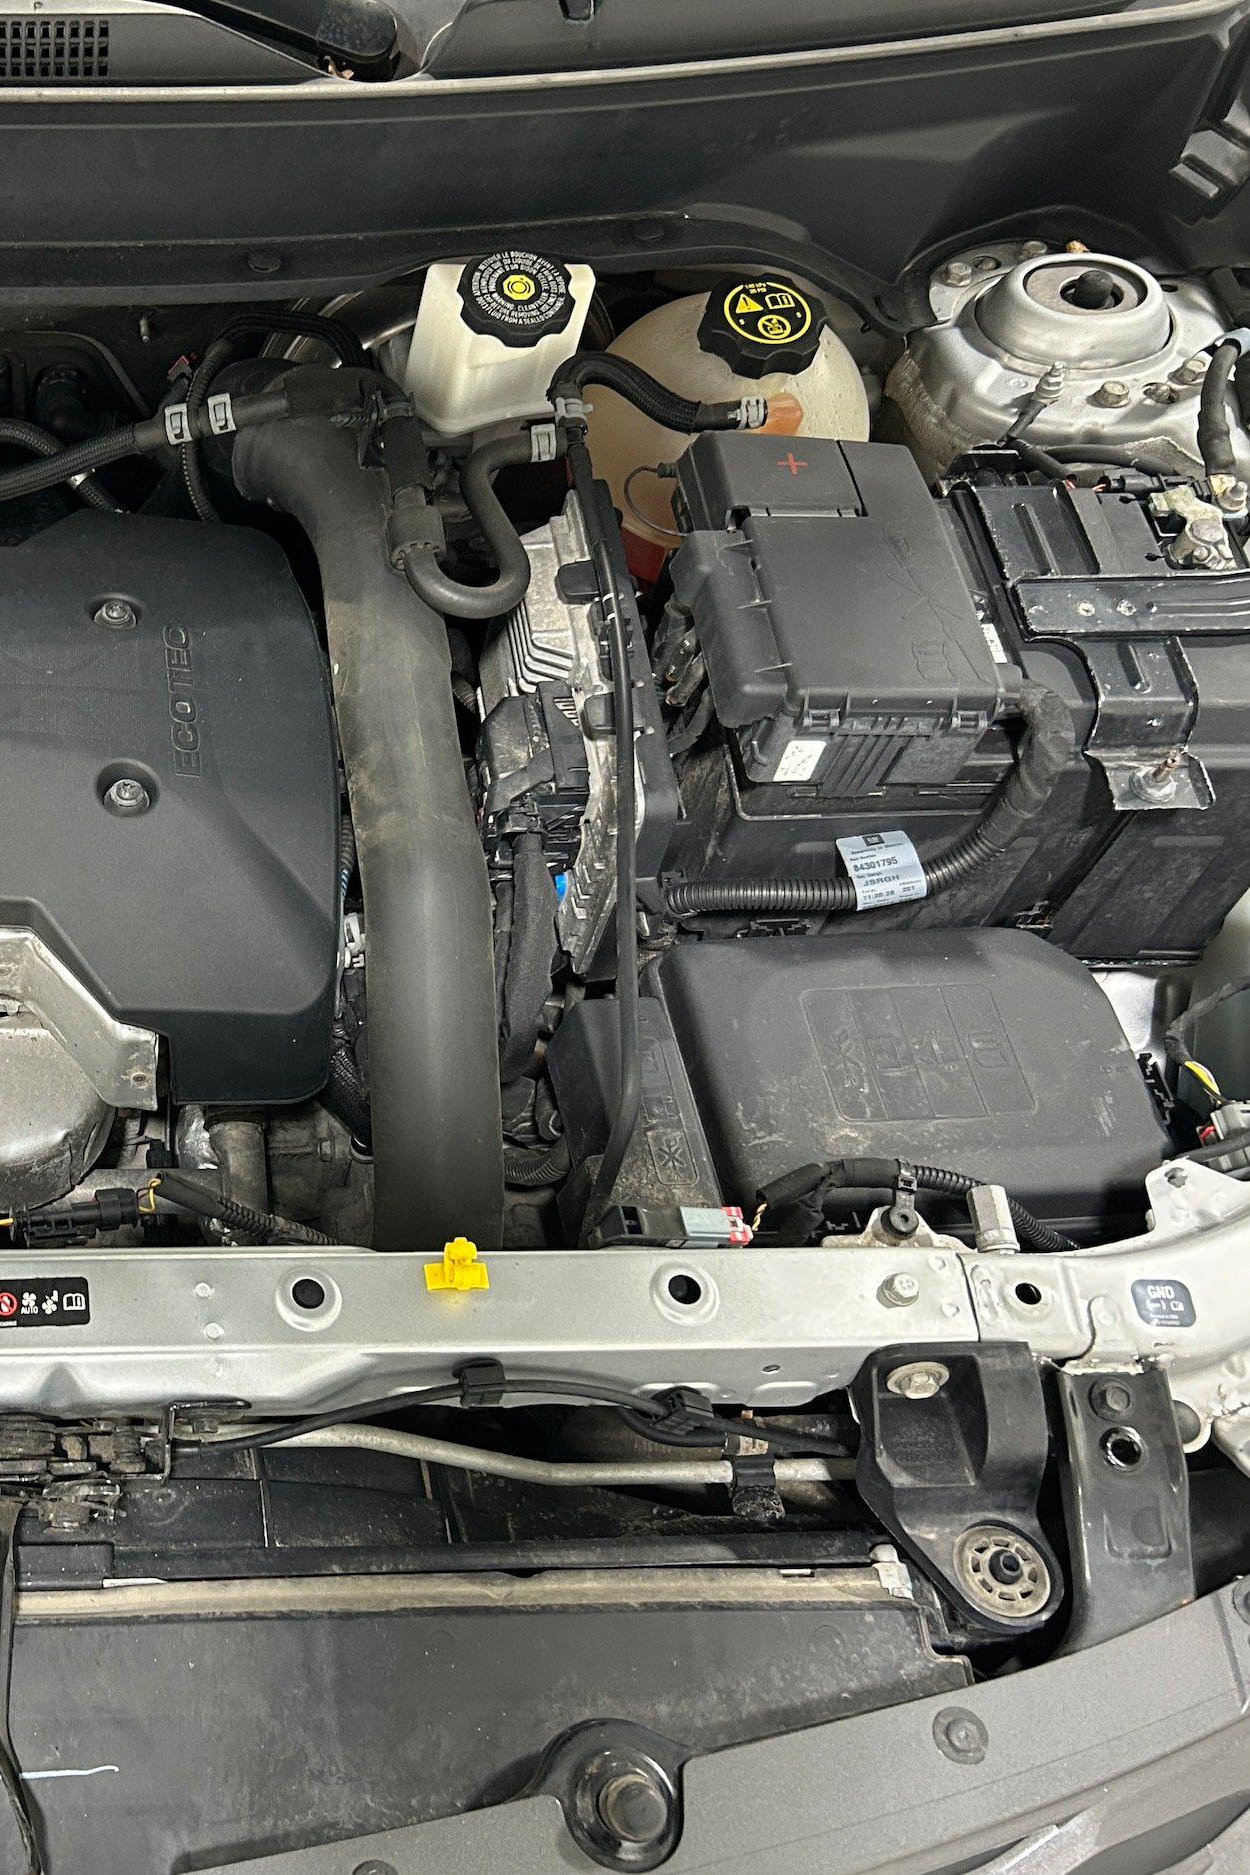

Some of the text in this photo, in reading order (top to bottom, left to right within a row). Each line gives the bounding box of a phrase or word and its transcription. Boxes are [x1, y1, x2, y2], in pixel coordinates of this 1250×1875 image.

[162, 624, 201, 778] ECOTEC
[853, 856, 898, 872] 84301795
[1147, 1285, 1175, 1299] GND
[21, 1306, 39, 1315] AUTO
